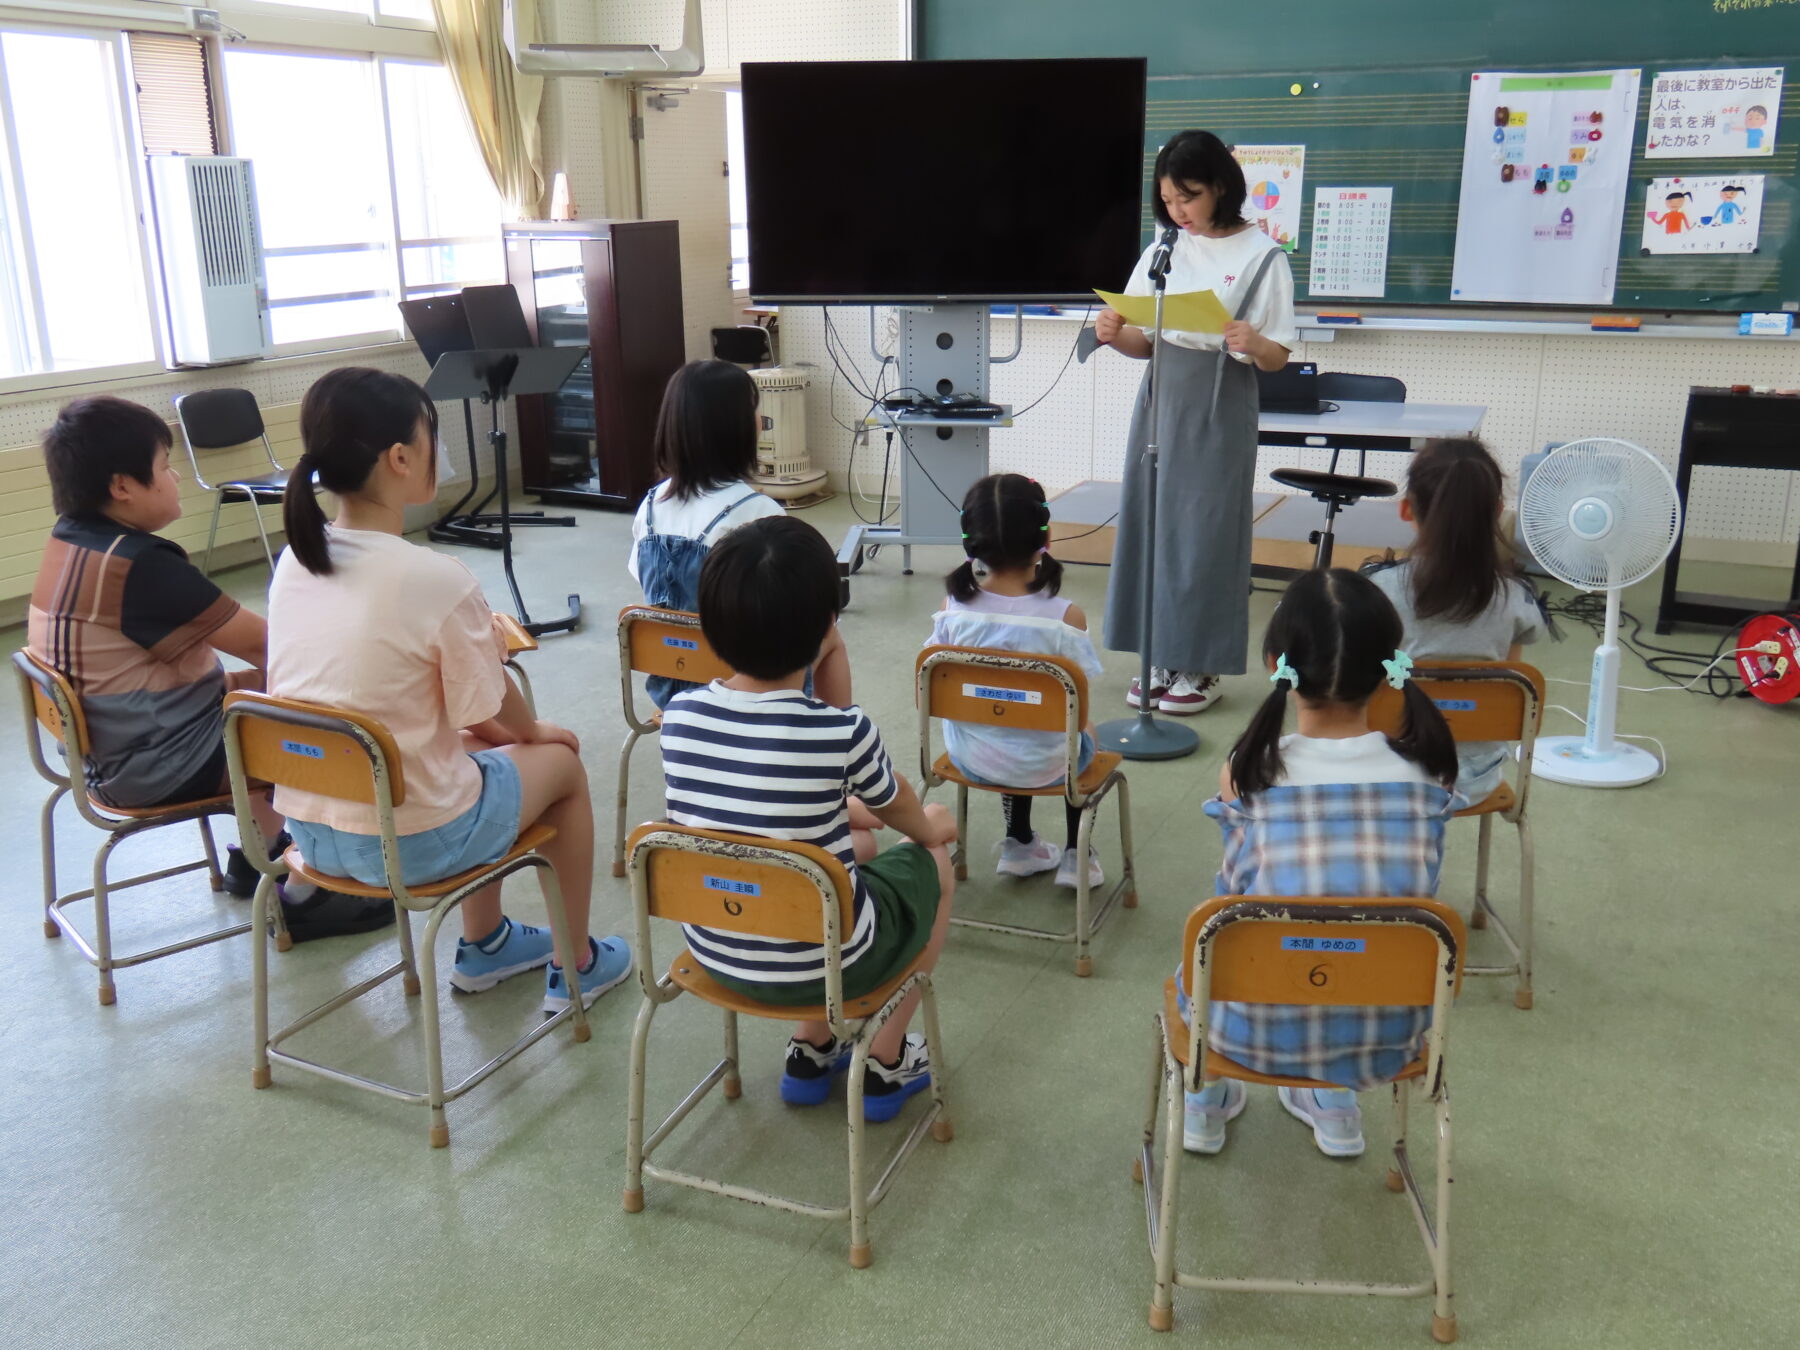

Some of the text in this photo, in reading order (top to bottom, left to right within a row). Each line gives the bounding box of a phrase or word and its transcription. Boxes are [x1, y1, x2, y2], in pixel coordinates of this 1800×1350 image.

[1656, 77, 1777, 93] 最後に教室から出た
[676, 656, 685, 672] 6
[305, 747, 319, 757] もも
[710, 878, 730, 891] 新山
[1290, 938, 1356, 951] 本間 ゆめの
[1309, 963, 1328, 987] 6
